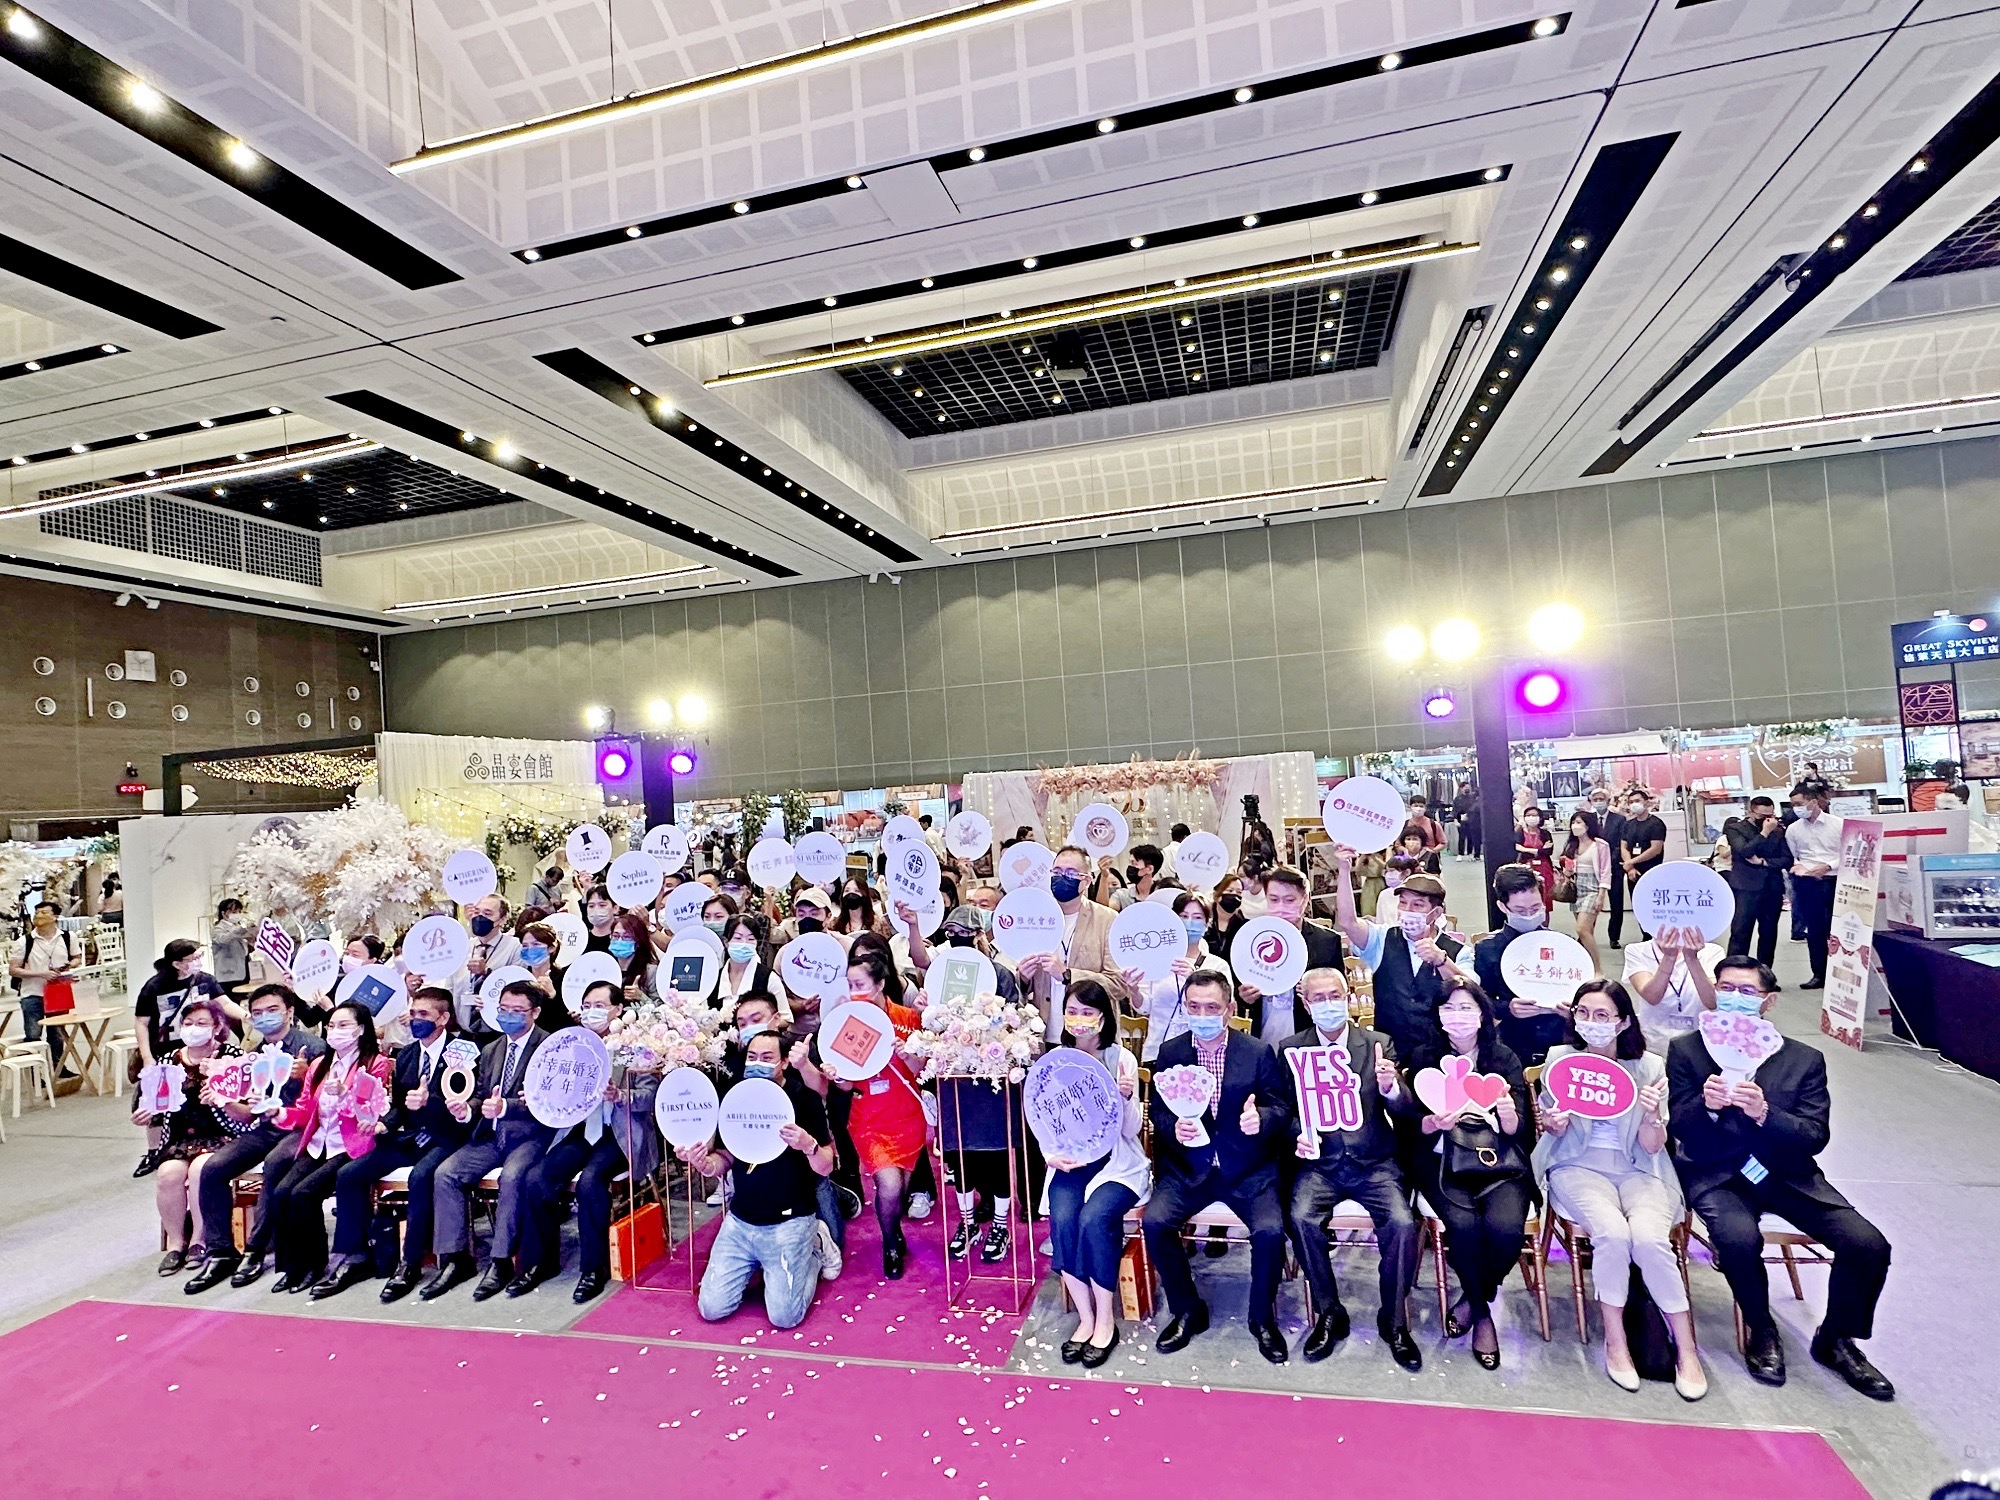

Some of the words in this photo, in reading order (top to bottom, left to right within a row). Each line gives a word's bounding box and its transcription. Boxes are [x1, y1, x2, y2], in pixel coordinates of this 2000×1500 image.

[1902, 642, 1943, 653] GREAT
[1947, 636, 1999, 648] SKYVIEW
[491, 753, 553, 779] 晶宴會館
[447, 867, 490, 882] CATHERINE
[621, 869, 648, 882] Sophia
[1652, 888, 1714, 907] 郭元益
[546, 1057, 599, 1080] 幸福婚宴
[1290, 1050, 1356, 1089] YES,
[1569, 1066, 1616, 1093] YES,
[211, 1070, 240, 1093] Marry
[1041, 1073, 1099, 1116] 幸福婚宴
[1567, 1084, 1577, 1099] I
[1580, 1087, 1617, 1107] DO!
[661, 1101, 684, 1113] FIRST
[686, 1100, 713, 1110] CLASS
[749, 1113, 788, 1121] DIAMONDS
[1317, 1088, 1359, 1128] DO
